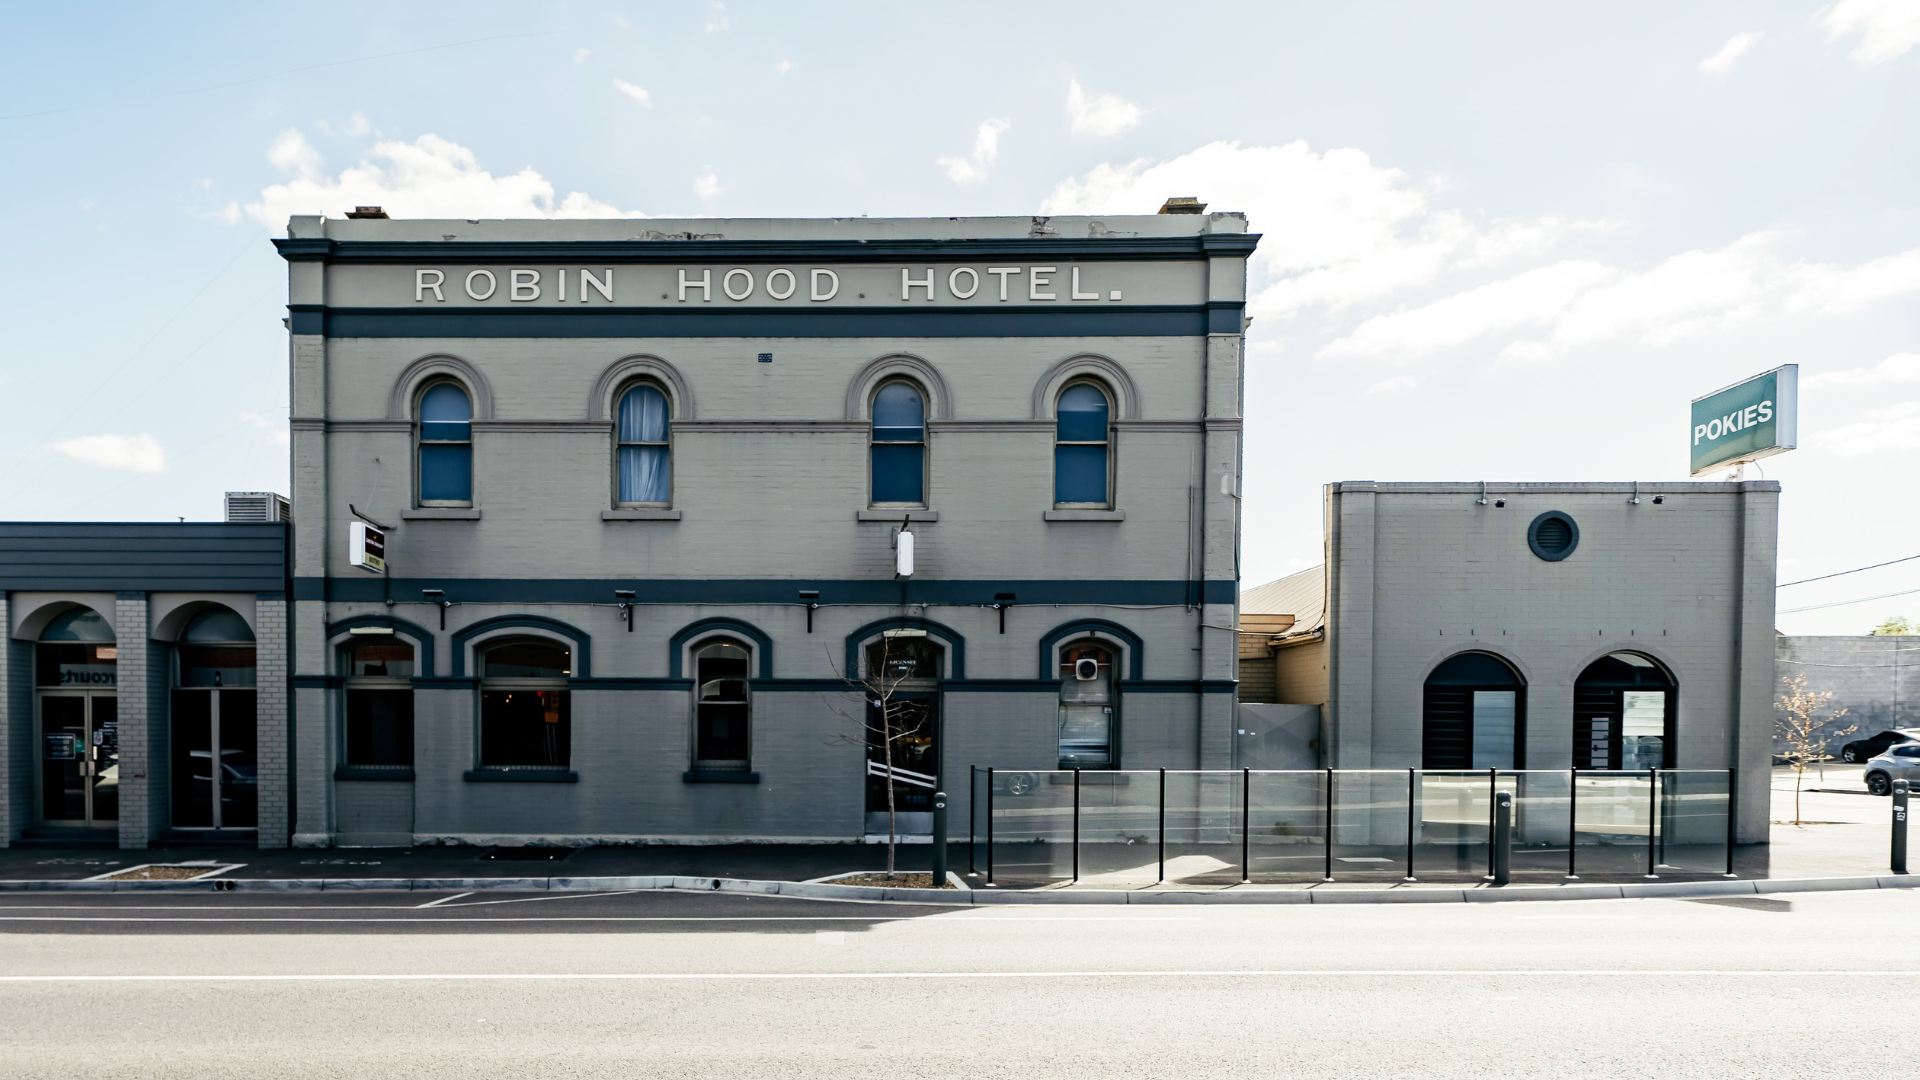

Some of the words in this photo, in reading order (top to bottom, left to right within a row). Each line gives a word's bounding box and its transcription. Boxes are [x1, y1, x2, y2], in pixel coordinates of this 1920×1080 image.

[415, 268, 613, 302] ROBIN
[678, 268, 840, 301] HOOD
[901, 266, 1122, 301] HOTEL.
[1694, 400, 1773, 446] POKIES
